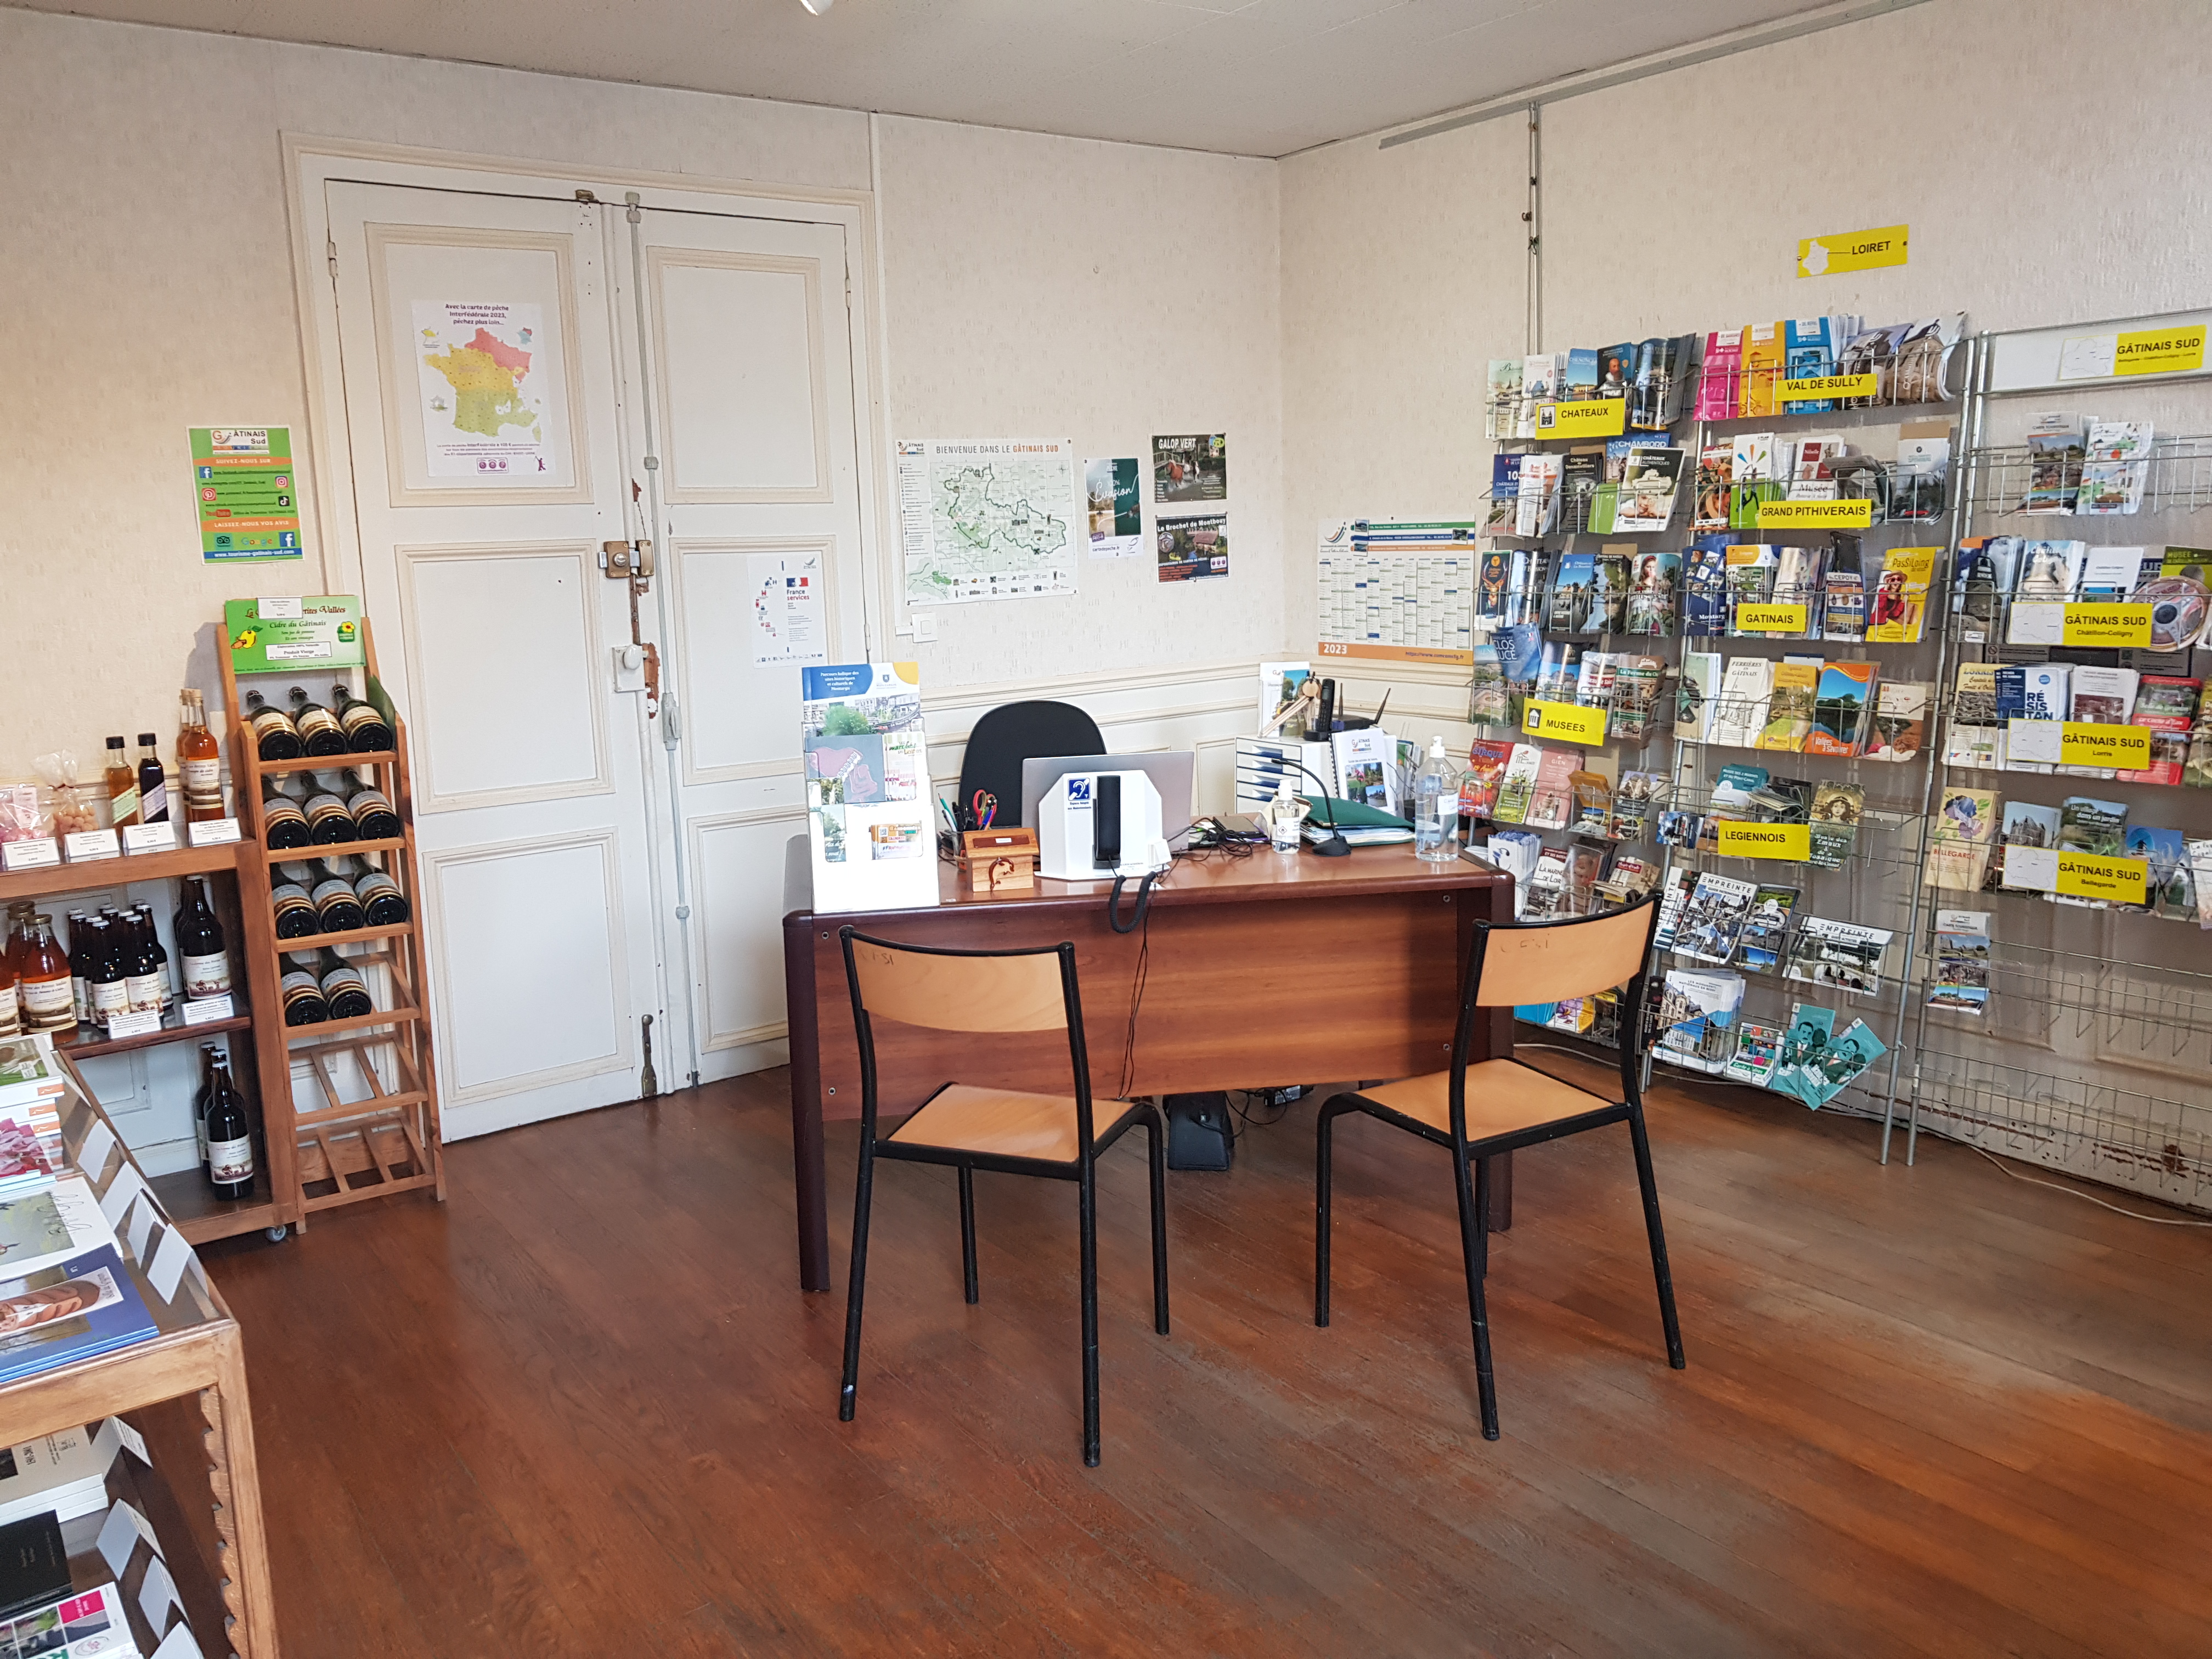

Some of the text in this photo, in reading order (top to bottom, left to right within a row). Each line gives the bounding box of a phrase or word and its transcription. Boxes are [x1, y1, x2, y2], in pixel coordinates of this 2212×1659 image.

[1852, 241, 1891, 256] LOIRET
[2117, 338, 2200, 354] GÂTINAIS SUD
[1787, 376, 1863, 391] VAL DE SULLY
[1561, 407, 1609, 419] CHATEAUX
[936, 445, 977, 454] BIENVENUE
[980, 445, 999, 453] DANS
[1013, 444, 1043, 453] GÂTINAIS
[1158, 438, 1196, 449] GALOP VERT
[1799, 484, 1828, 493] Musée
[1762, 506, 1866, 516] GRAND PITHIVERAIS
[241, 537, 273, 546] Google
[245, 608, 255, 618] La
[1746, 614, 1794, 624] GATINAIS
[2065, 614, 2146, 625] GÂTINAIS SUD
[1323, 644, 1347, 654] 2023
[1493, 639, 1515, 650] CLOS
[2026, 690, 2045, 702] RÉ
[2026, 702, 2047, 711] SIS
[1546, 719, 1585, 732] MUSEES
[2063, 733, 2145, 748] GÂTINAIS SUD
[1725, 831, 1786, 842] LEGIENNOIS
[1933, 849, 1976, 860] BELLEGARDE
[1538, 863, 1547, 872] LA
[2059, 863, 2141, 881] GÂTINAIS SUD
[1549, 874, 1562, 884] LOIR
[2081, 879, 2117, 889] Bellegarde
[1702, 877, 1752, 893] EMPREINTE
